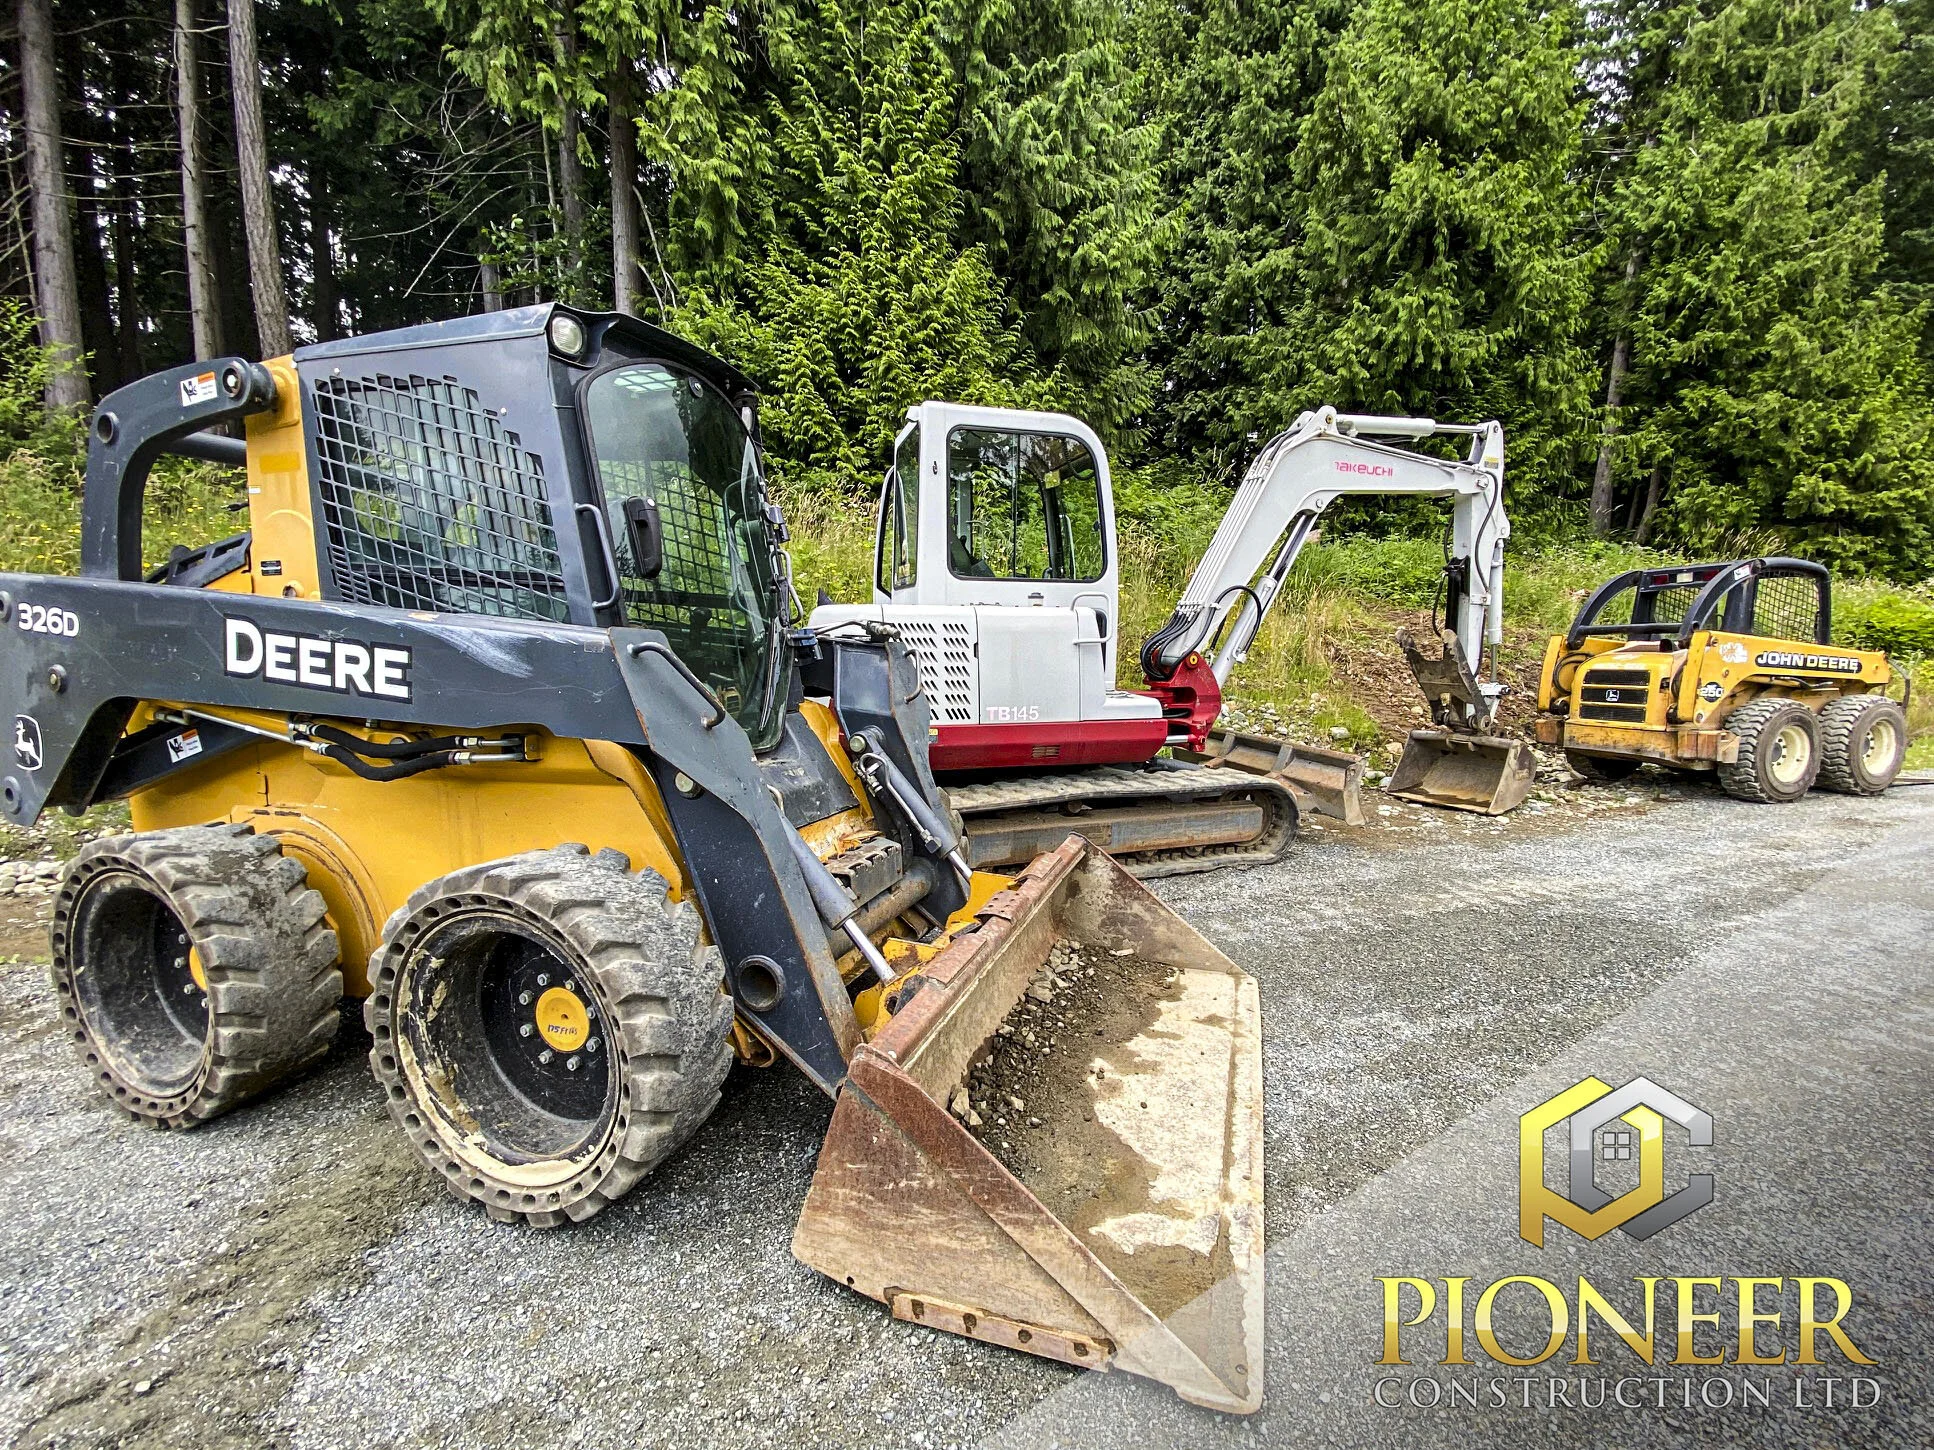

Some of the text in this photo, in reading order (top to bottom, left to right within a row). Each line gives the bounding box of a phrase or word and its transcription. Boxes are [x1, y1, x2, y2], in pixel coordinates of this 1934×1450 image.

[18, 602, 79, 637] 326D
[225, 617, 410, 699] DEERE
[1757, 652, 1859, 671] JOHN DEERE
[986, 706, 1040, 721] TB145
